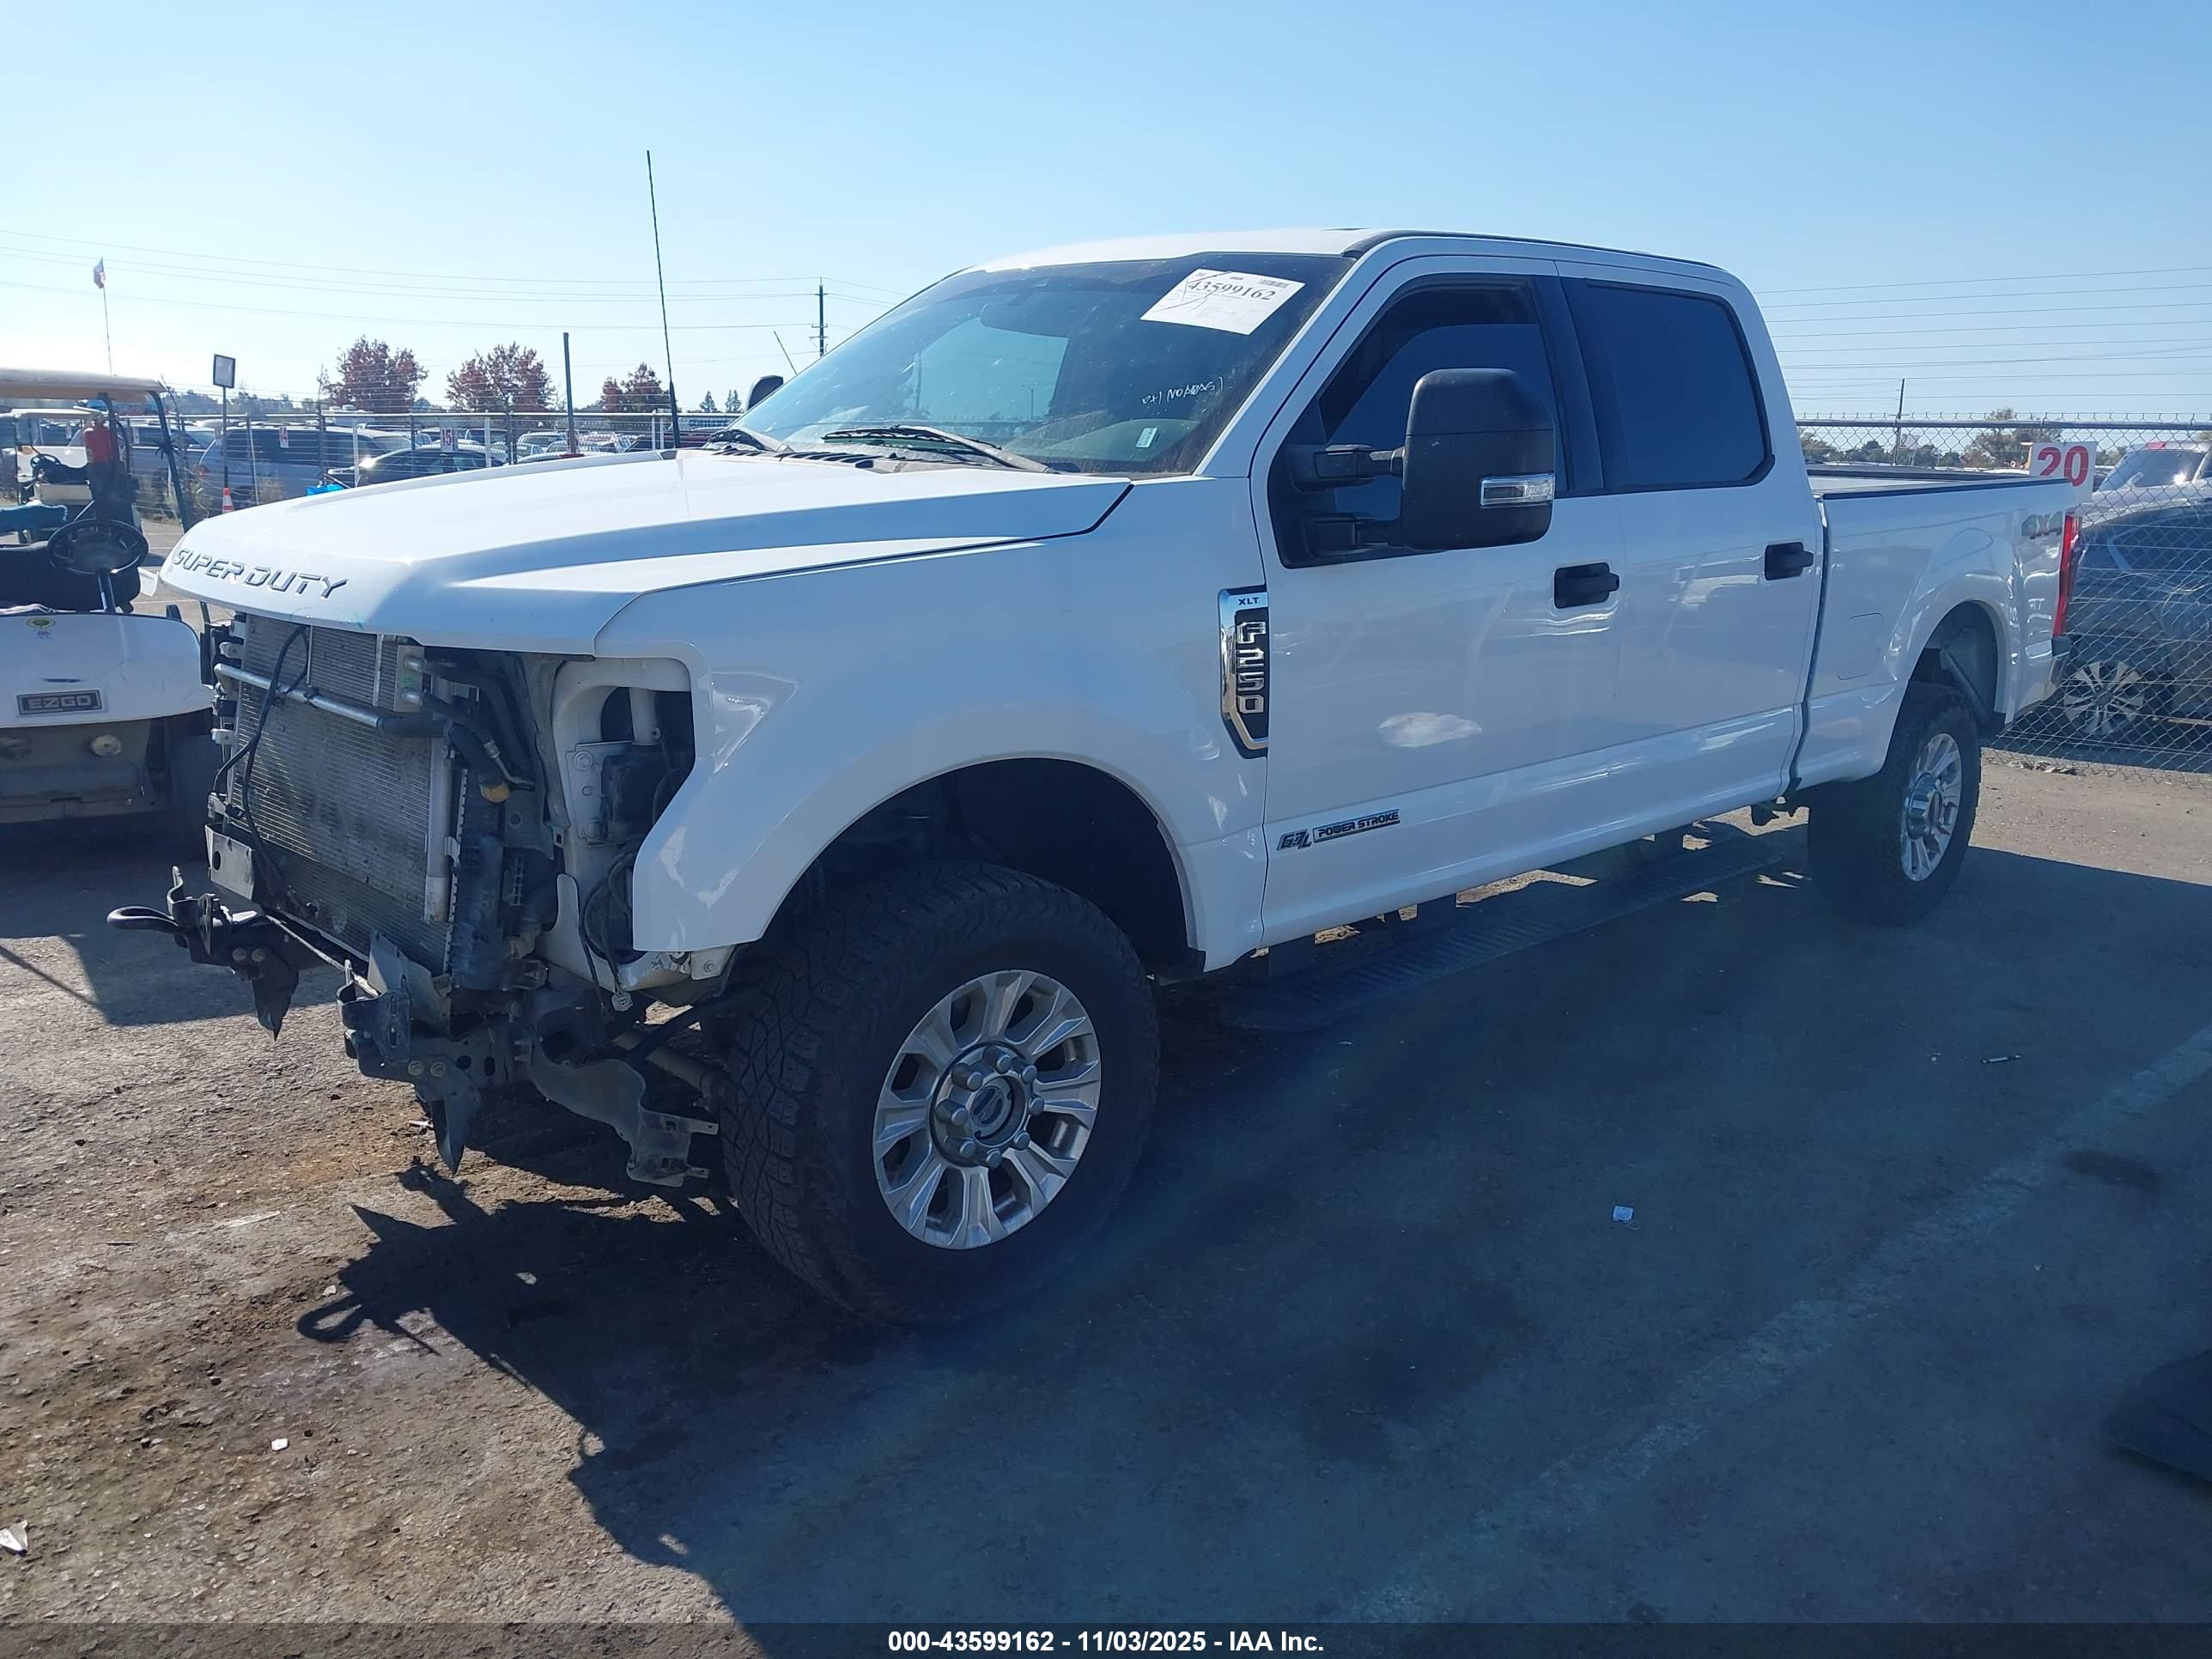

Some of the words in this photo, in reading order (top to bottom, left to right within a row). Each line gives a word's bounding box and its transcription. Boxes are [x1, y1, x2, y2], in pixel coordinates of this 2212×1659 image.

[1188, 281, 1277, 301] 43599162
[2037, 445, 2089, 487] 20
[172, 549, 245, 581] SUPER
[244, 565, 349, 599] DUTY
[1238, 597, 1260, 606] XLT
[1358, 811, 1400, 830] STROKE
